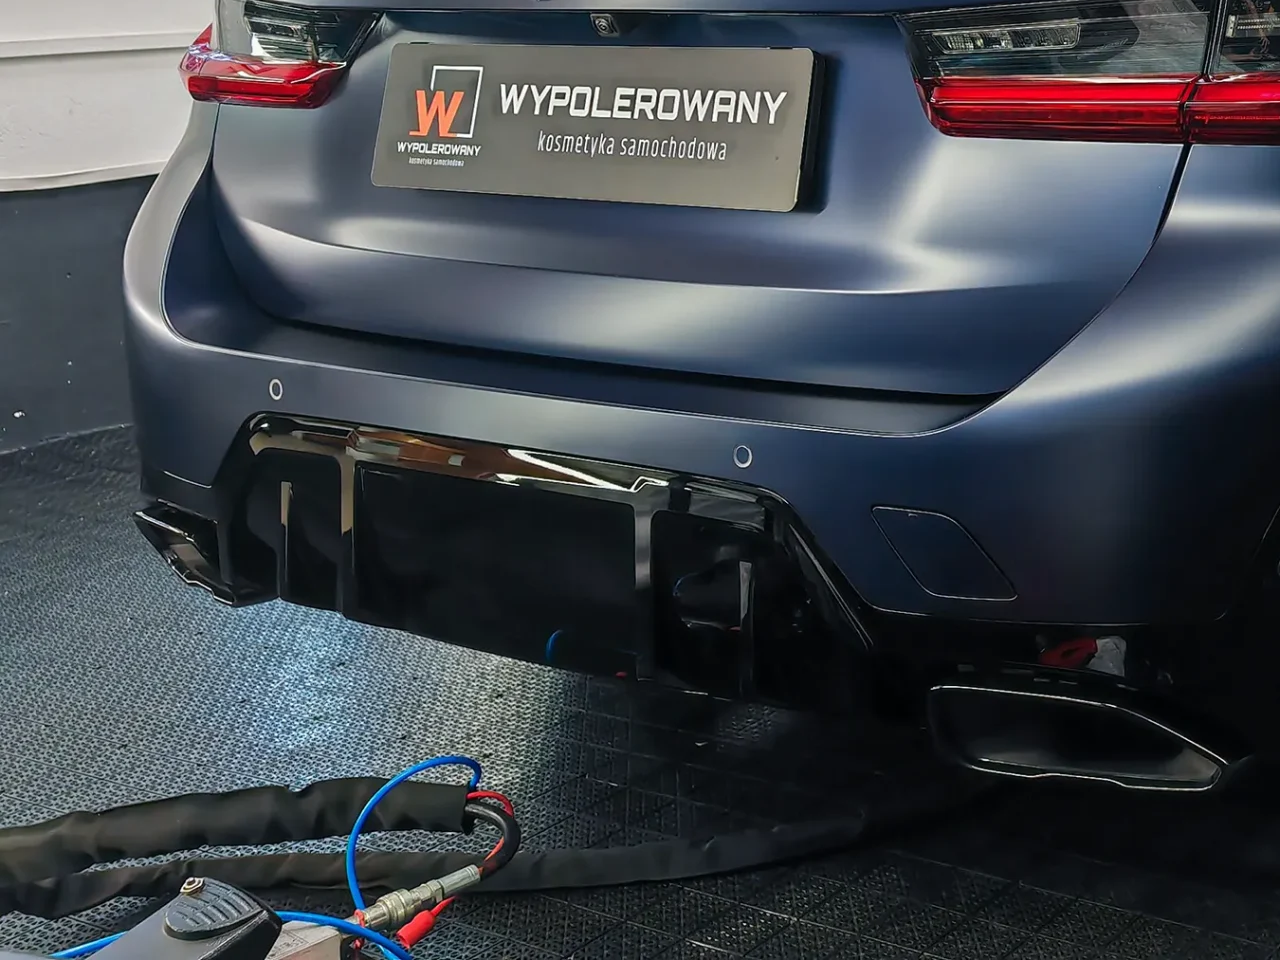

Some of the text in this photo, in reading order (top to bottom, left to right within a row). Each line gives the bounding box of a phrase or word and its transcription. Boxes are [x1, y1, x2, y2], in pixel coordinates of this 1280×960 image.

[409, 90, 465, 137] W
[500, 83, 788, 125] WYPOLEROWANY
[397, 141, 482, 156] WYPOLEROWANY
[537, 130, 728, 161] kosmetyka samochodowa
